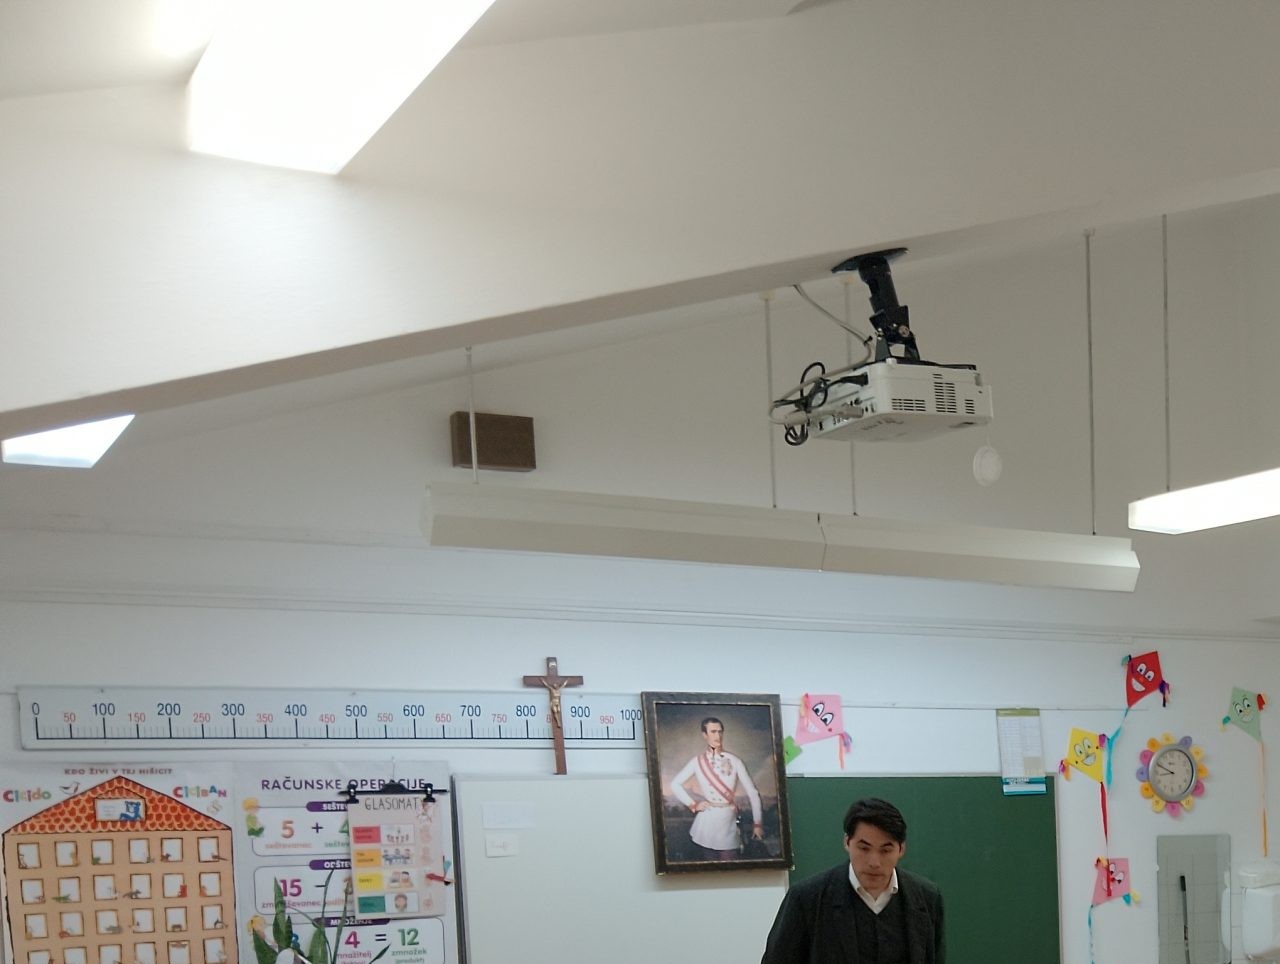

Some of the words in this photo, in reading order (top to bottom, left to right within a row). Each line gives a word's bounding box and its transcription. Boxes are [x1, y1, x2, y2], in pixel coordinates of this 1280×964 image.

[32, 703, 40, 716] 0
[92, 702, 115, 716] 100
[157, 703, 181, 716] 200
[221, 703, 245, 716] 300
[284, 704, 308, 717] 400
[345, 705, 367, 717] 500
[403, 705, 425, 717] 600
[460, 705, 481, 717] 700
[516, 705, 536, 717] 800
[570, 705, 590, 718] 900
[620, 709, 642, 721] 1000
[63, 713, 76, 723] 50
[128, 713, 146, 723] 150
[193, 713, 211, 723] 250
[256, 713, 273, 723] 350
[318, 714, 336, 724] 450
[377, 713, 393, 723] 550
[435, 713, 452, 723] 650
[491, 713, 507, 724] 750
[600, 715, 614, 725] 950
[261, 777, 341, 790] RAČUNSKE
[365, 797, 419, 811] GLASOMAT
[281, 821, 294, 838] 5
[280, 879, 302, 896] 15
[345, 931, 360, 948] 4
[398, 928, 420, 946] 12
